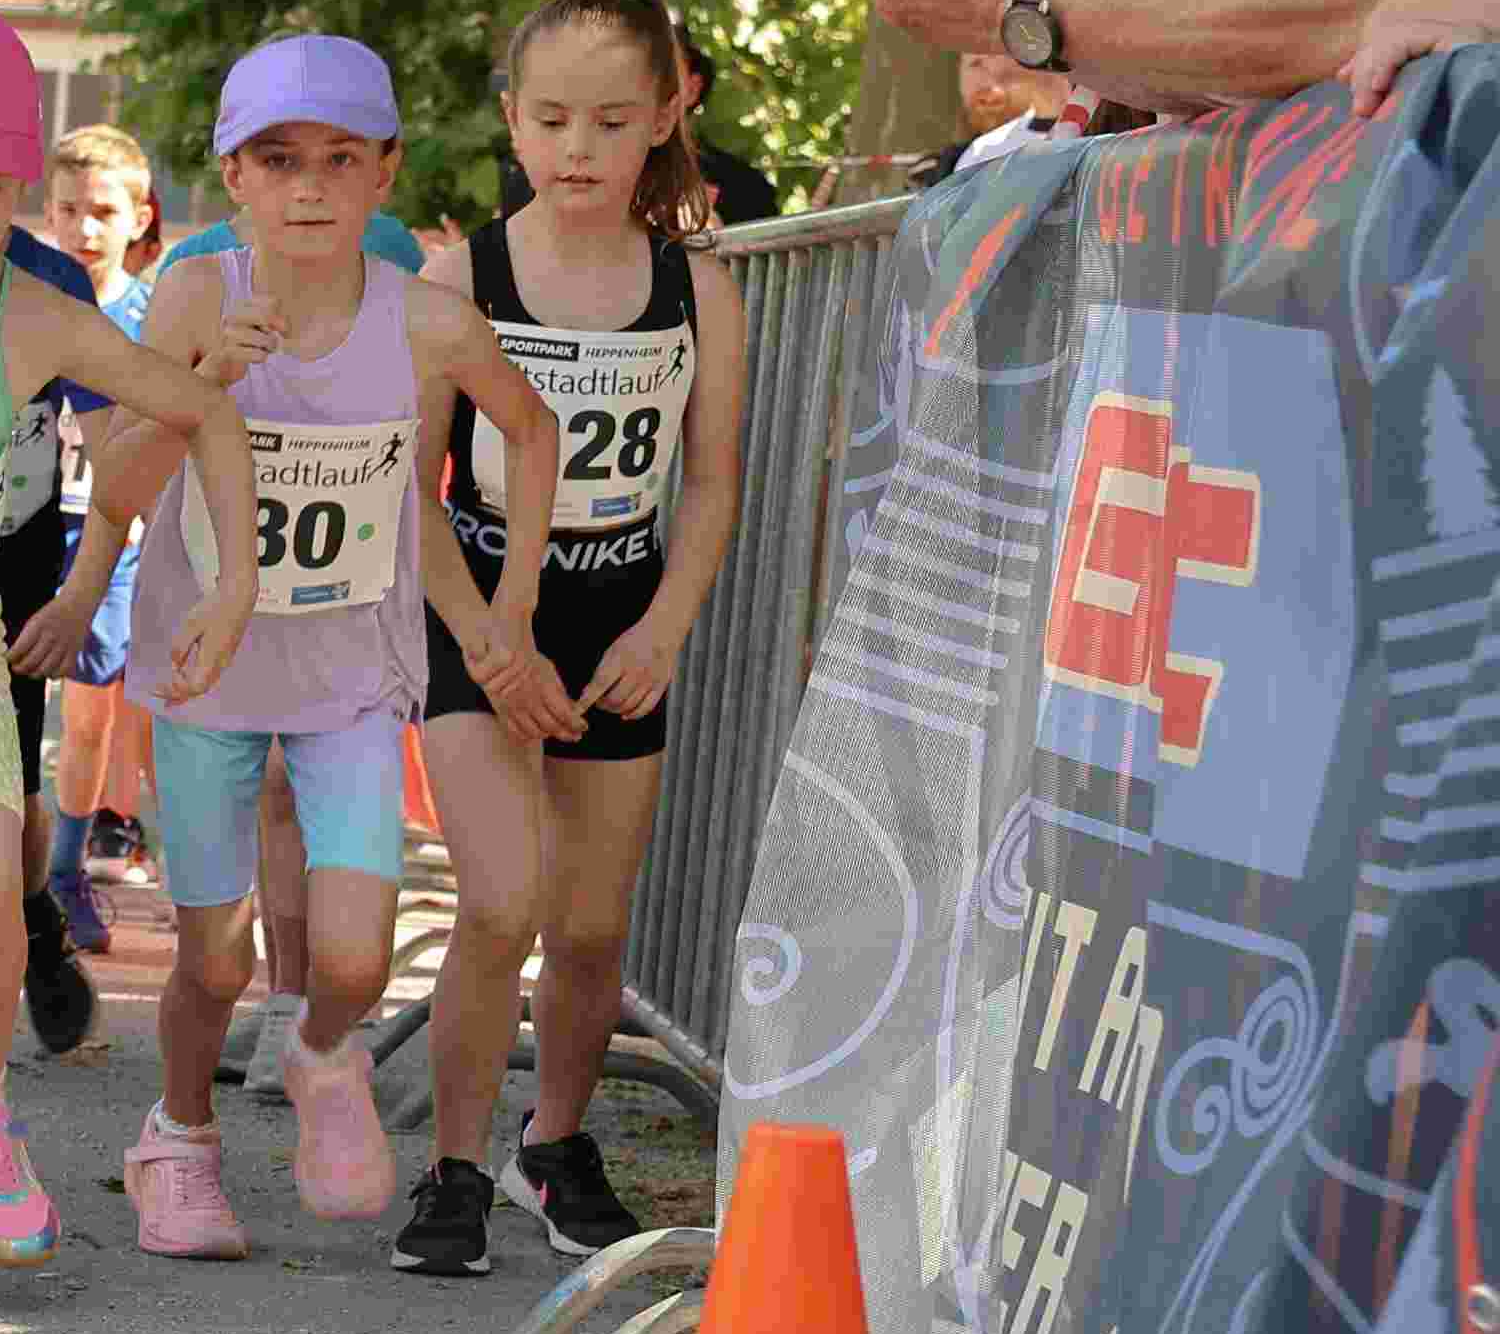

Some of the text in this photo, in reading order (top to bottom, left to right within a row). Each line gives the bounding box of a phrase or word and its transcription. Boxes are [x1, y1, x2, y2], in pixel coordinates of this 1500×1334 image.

[500, 338, 662, 359] SPORTPARK HEPPENHEIM
[287, 438, 373, 452] HEPPENHEIM
[562, 406, 662, 481] 28
[542, 527, 650, 572] NIKE
